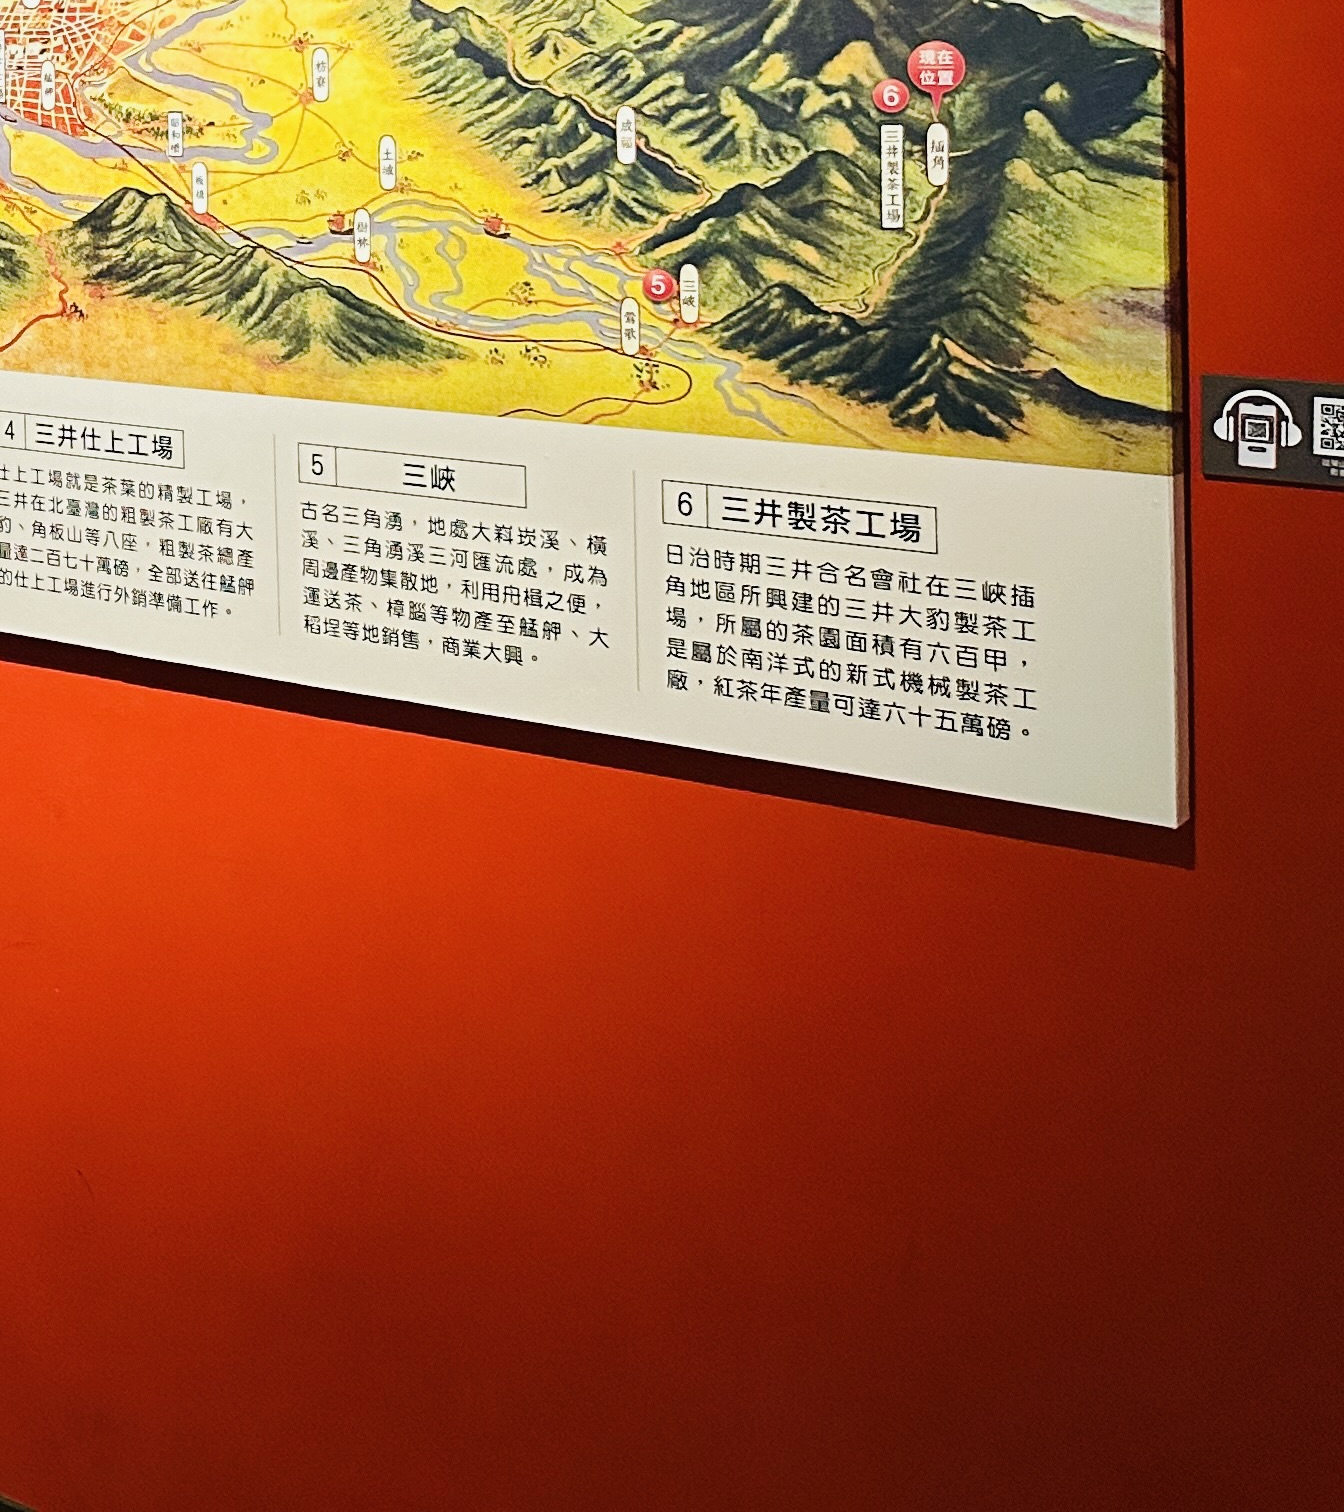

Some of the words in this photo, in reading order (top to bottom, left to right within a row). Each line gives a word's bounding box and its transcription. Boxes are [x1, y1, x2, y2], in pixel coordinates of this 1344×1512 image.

[918, 48, 954, 67] 現在
[919, 69, 955, 87] 位置
[882, 86, 897, 108] 6
[884, 128, 902, 224] 三井製茶工場
[650, 275, 666, 295] 5
[4, 420, 16, 441] 4
[35, 421, 174, 461] 三井仕上工場
[311, 453, 324, 476] 5
[402, 462, 456, 493] 三峽
[677, 491, 693, 518] 6
[721, 495, 923, 544] 三井製茶工場
[666, 543, 1036, 610] 日治時期三井合名會社在三峽插
[665, 573, 1037, 644] 角地區所興建的三井大豹製茶工
[666, 638, 1038, 712] 是屬於南洋式的新式機械製茶工
